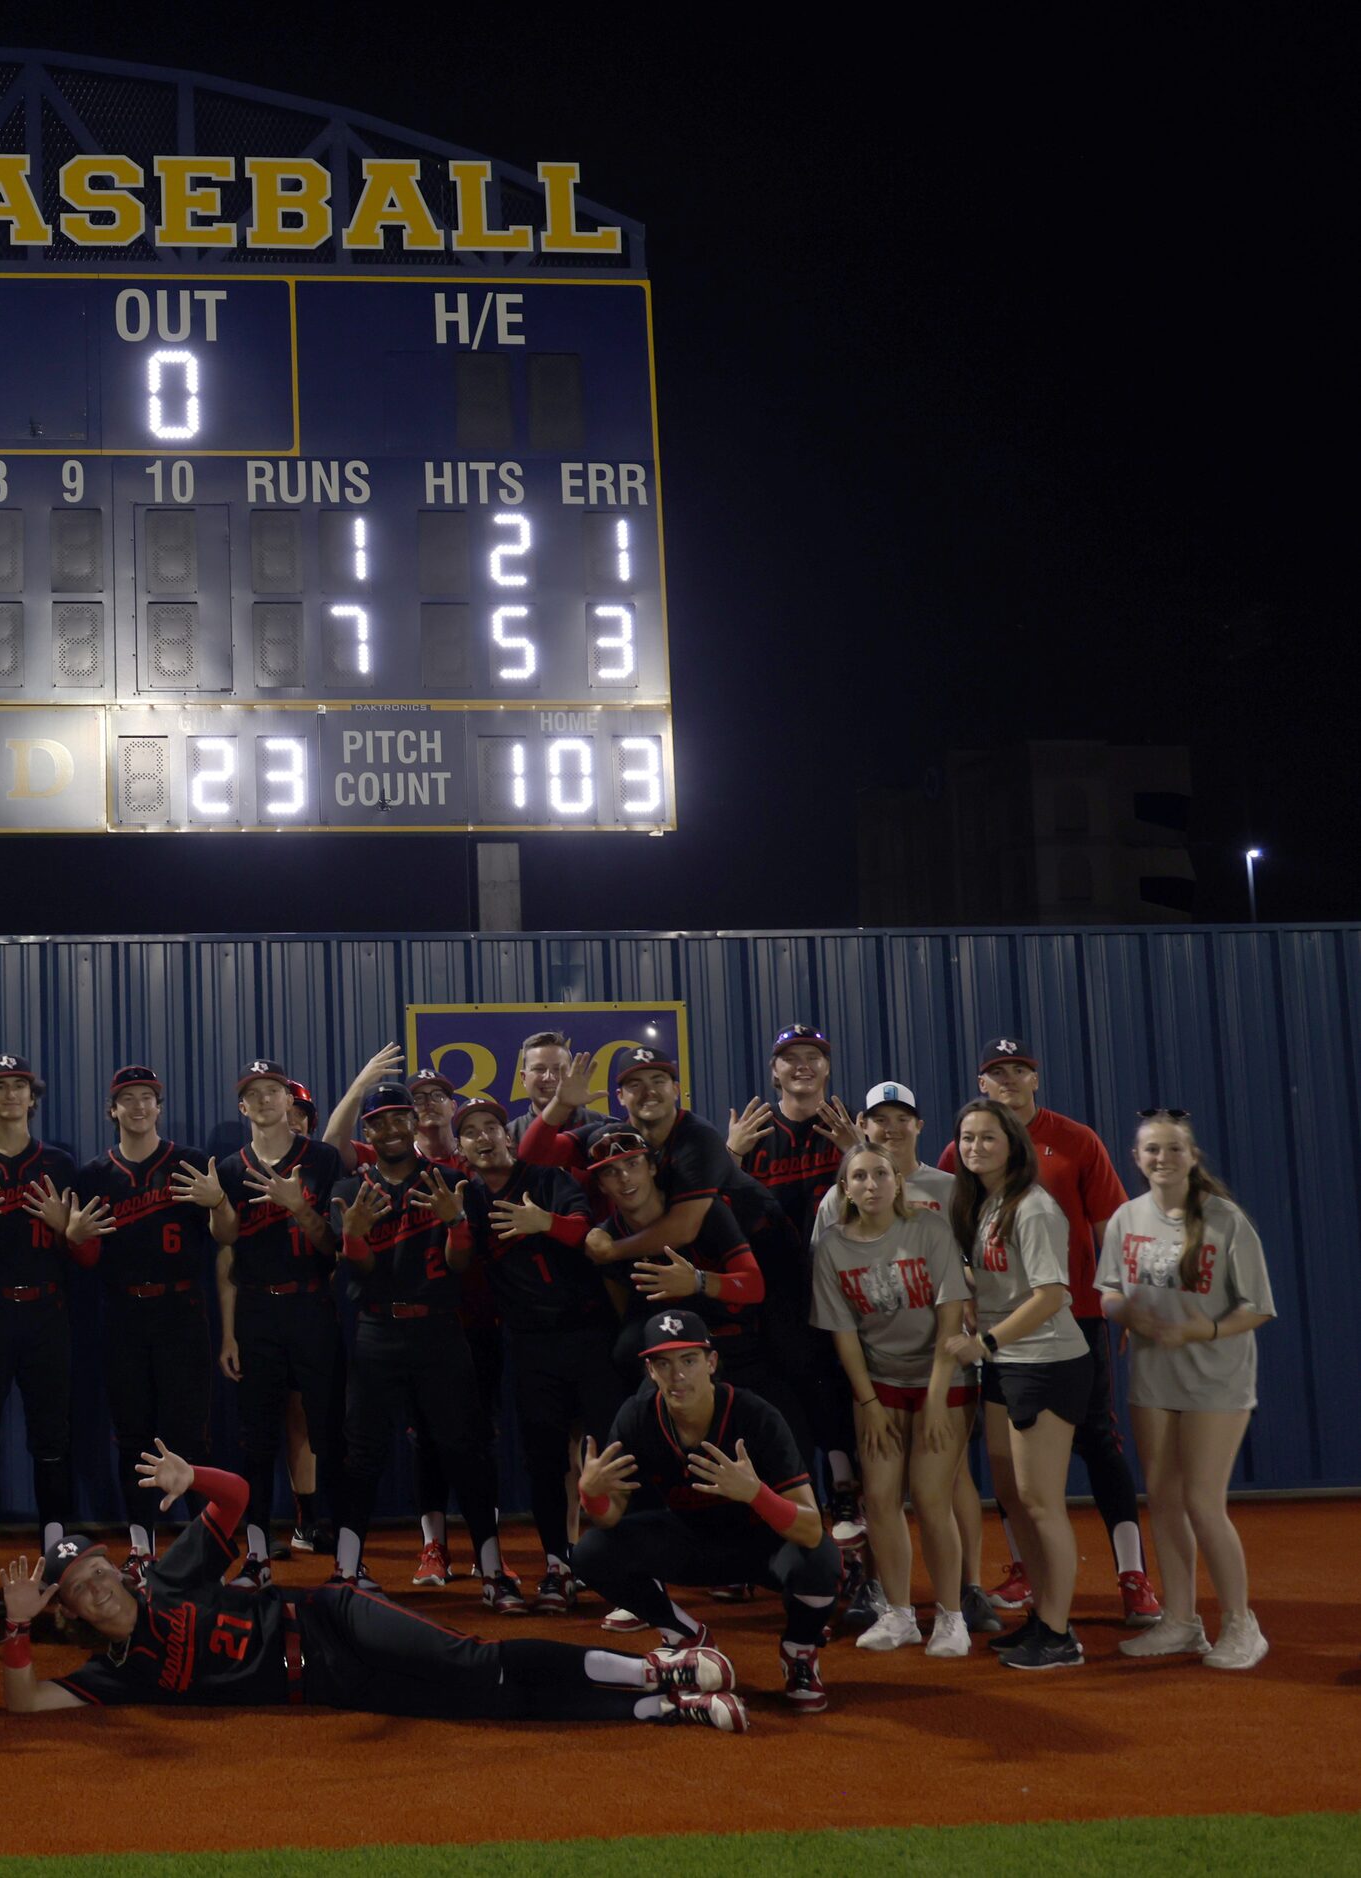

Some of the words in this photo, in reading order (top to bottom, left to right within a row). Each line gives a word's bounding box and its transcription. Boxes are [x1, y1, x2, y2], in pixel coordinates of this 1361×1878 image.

[115, 289, 227, 343] OUT
[435, 291, 526, 349] H/E
[149, 350, 199, 440] 0
[62, 460, 84, 503] 9
[145, 461, 194, 503] 10
[246, 460, 371, 505] RUNS
[425, 462, 525, 506] HITS
[561, 463, 647, 507] ERR
[354, 517, 366, 580] 1
[490, 512, 531, 586] 2
[617, 518, 630, 581] 1
[331, 605, 370, 675] 7
[492, 607, 536, 679] 5
[596, 606, 634, 679] 3
[355, 704, 428, 712] DAKTRONICS
[540, 711, 599, 732] HOME
[343, 730, 442, 764] PITCH
[192, 738, 305, 814] 23
[335, 772, 451, 806] COUNT
[512, 738, 661, 813] 103
[162, 1223, 182, 1254] 6
[425, 1247, 447, 1280] 2
[209, 1613, 254, 1662] 21
